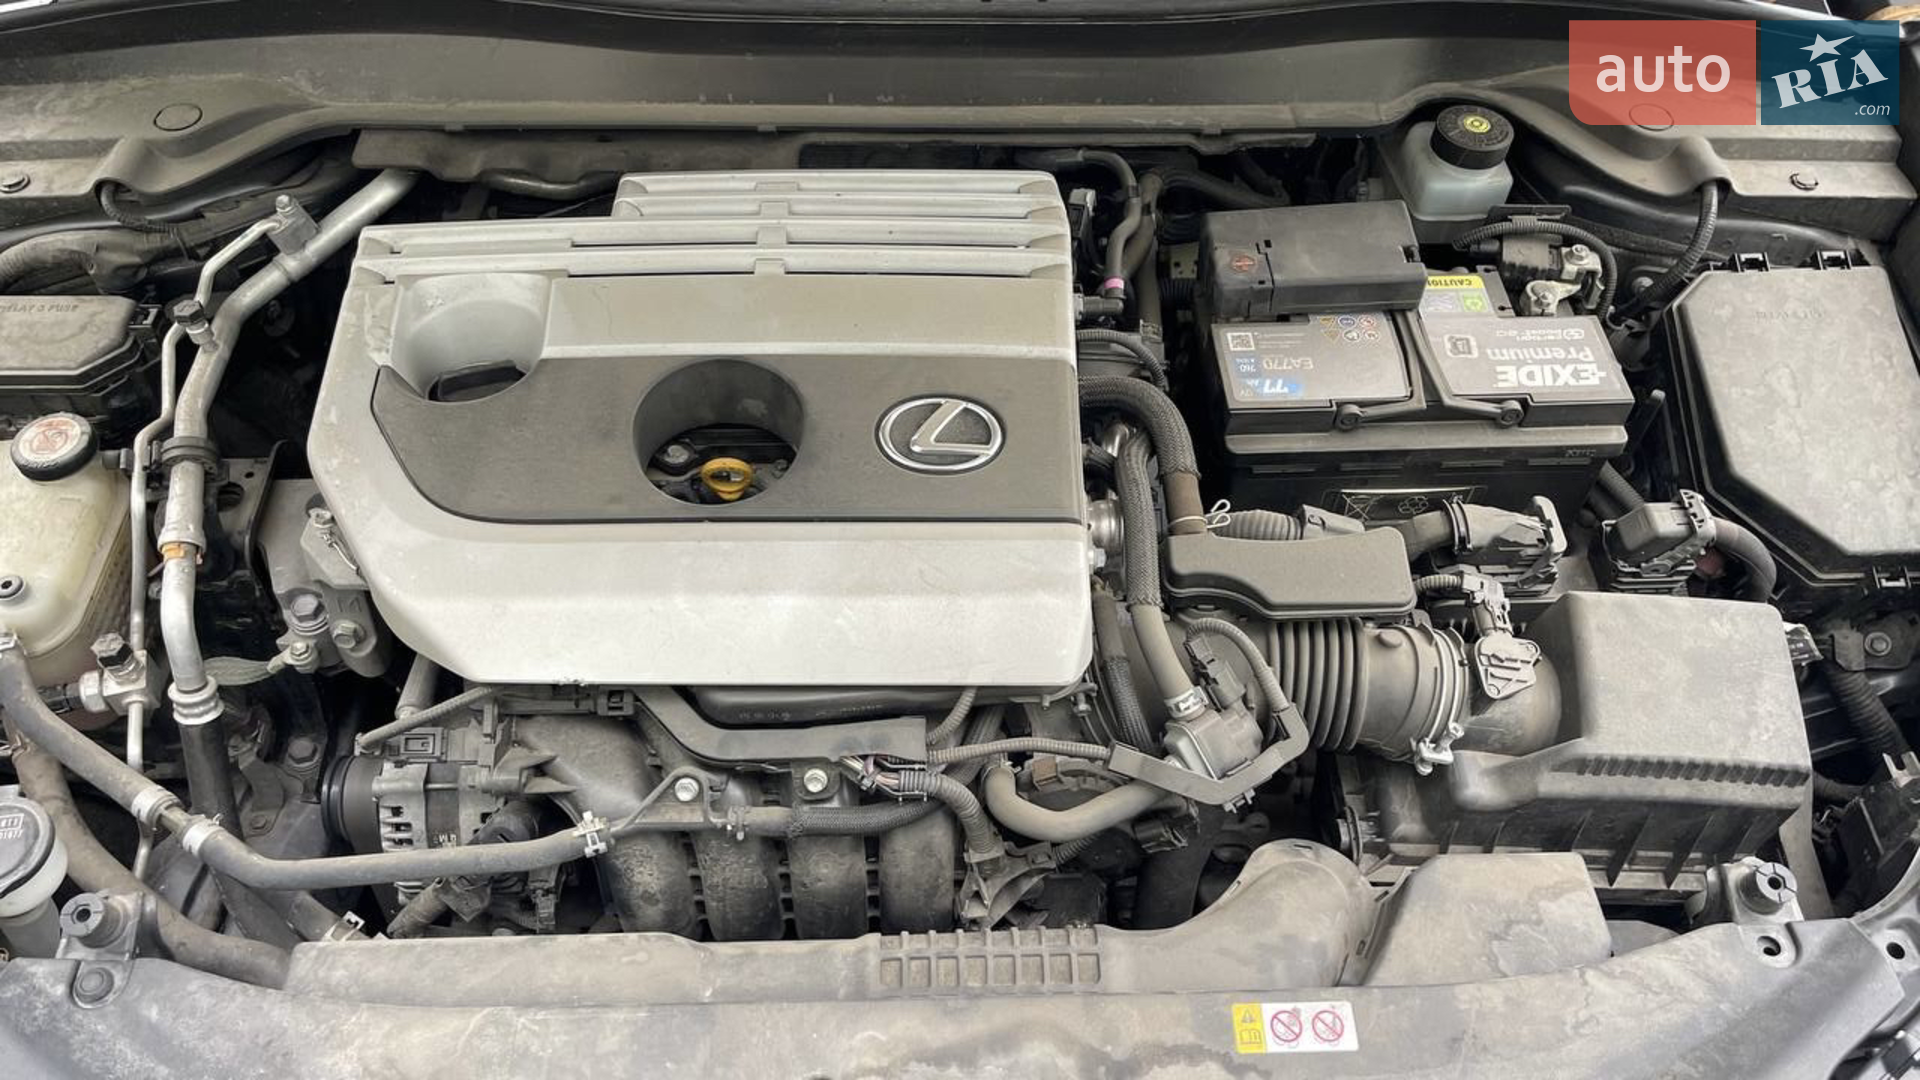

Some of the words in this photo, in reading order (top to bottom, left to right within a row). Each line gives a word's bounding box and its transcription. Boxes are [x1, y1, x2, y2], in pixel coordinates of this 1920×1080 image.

[1487, 346, 1595, 363] Premium
[1263, 357, 1314, 370] EA770
[1497, 363, 1606, 388] EXIDE
[1263, 379, 1289, 394] 77
